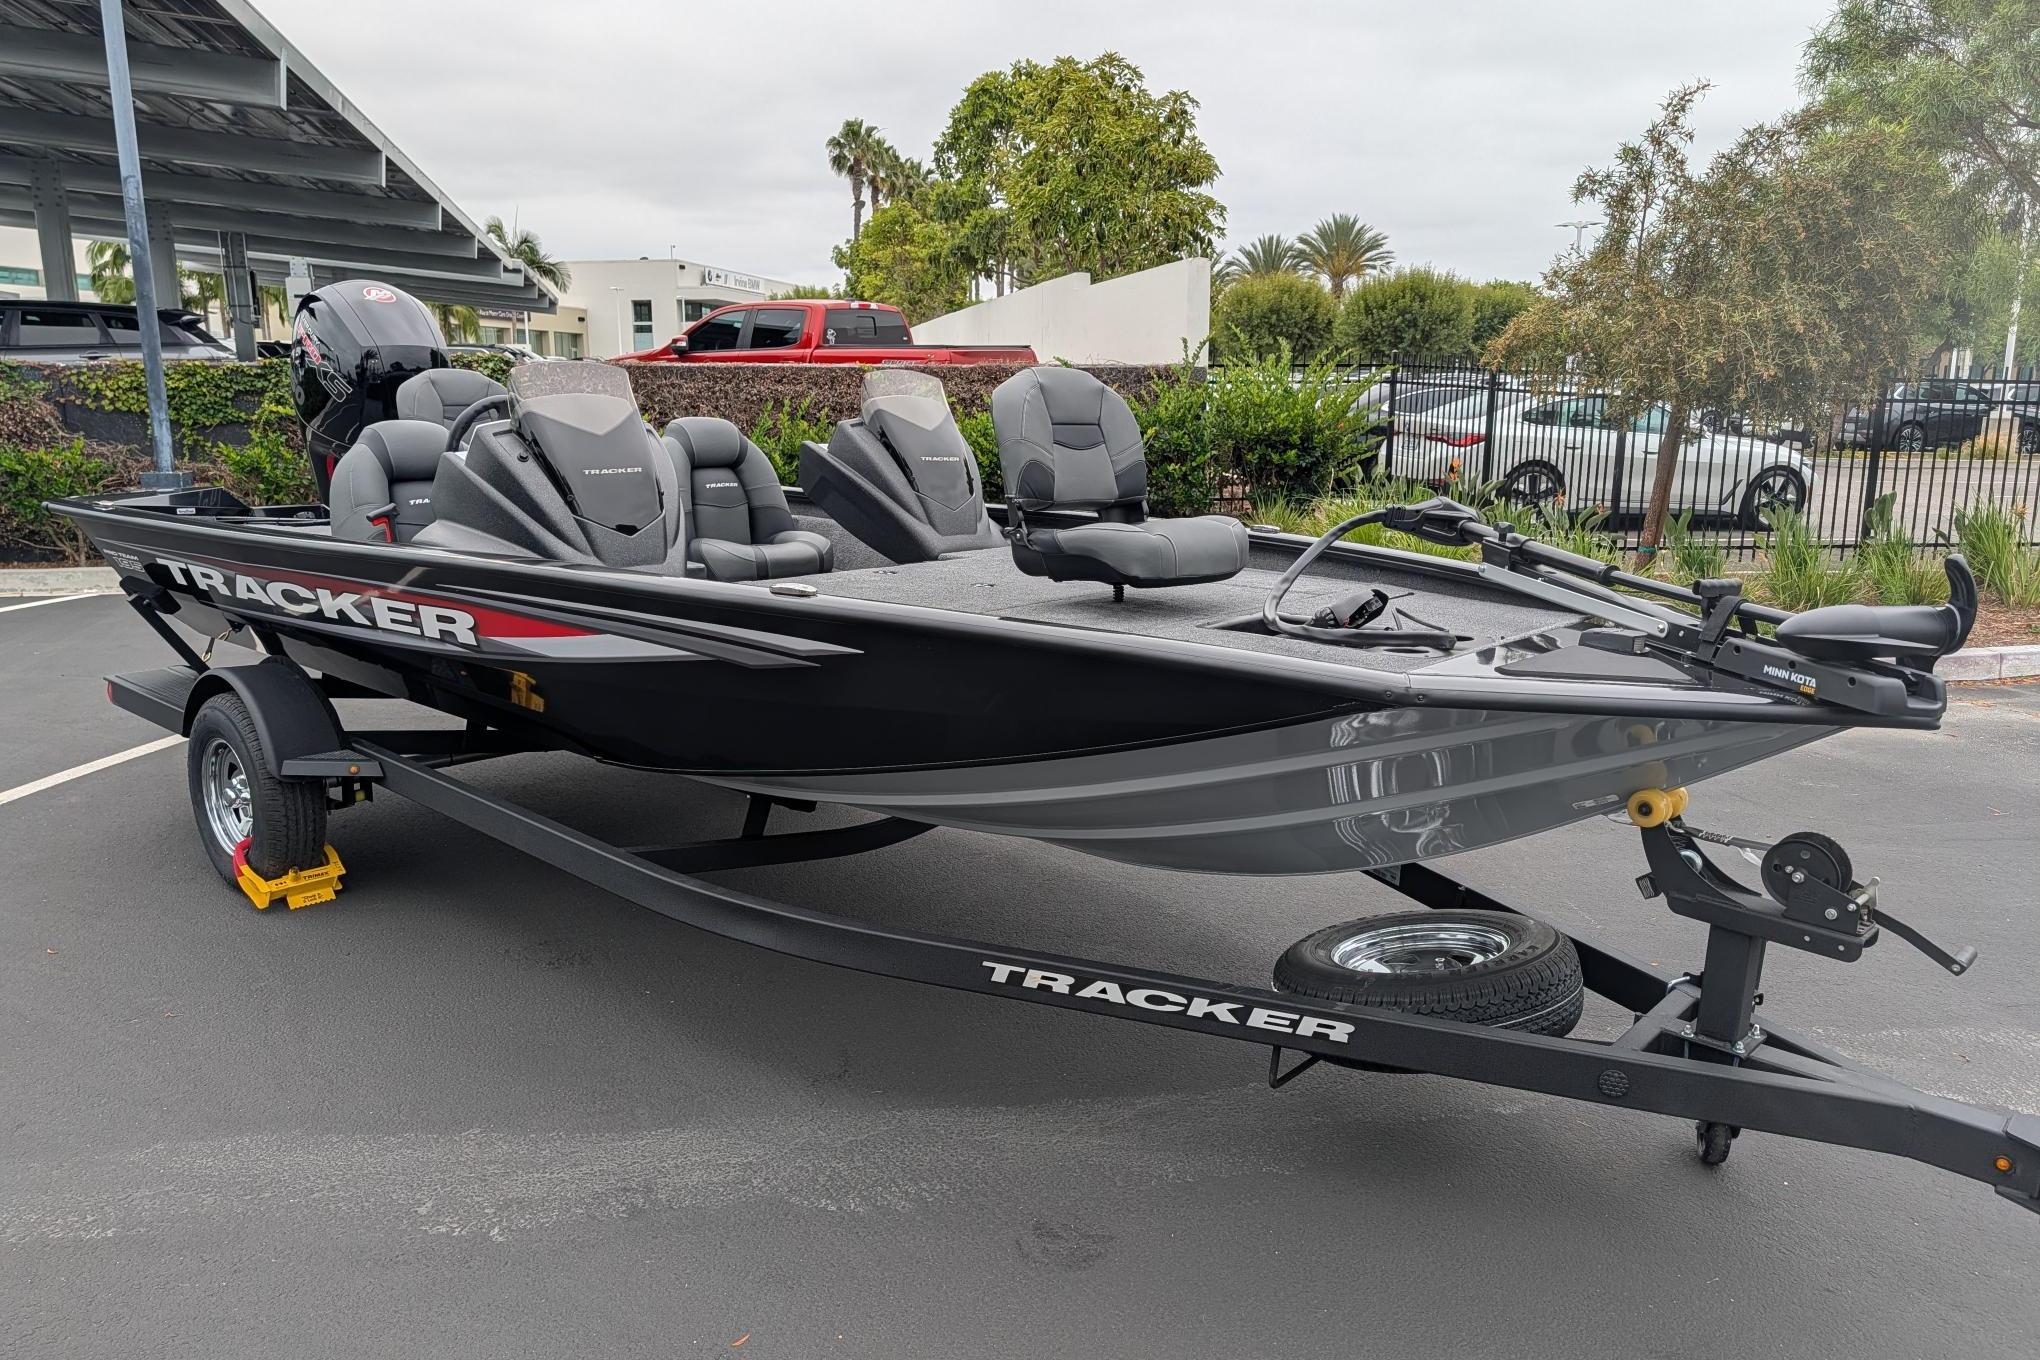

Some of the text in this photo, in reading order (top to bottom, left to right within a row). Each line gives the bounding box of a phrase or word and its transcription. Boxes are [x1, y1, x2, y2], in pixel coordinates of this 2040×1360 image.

[733, 275, 760, 291] Irvine BMW
[583, 467, 642, 475] TRACKER
[155, 557, 478, 646] TRACKER
[1763, 664, 1817, 688] MINN KOTA
[1799, 684, 1816, 695] EDGE
[303, 870, 330, 881] TRIMAX
[982, 960, 1356, 1043] TRACKER
